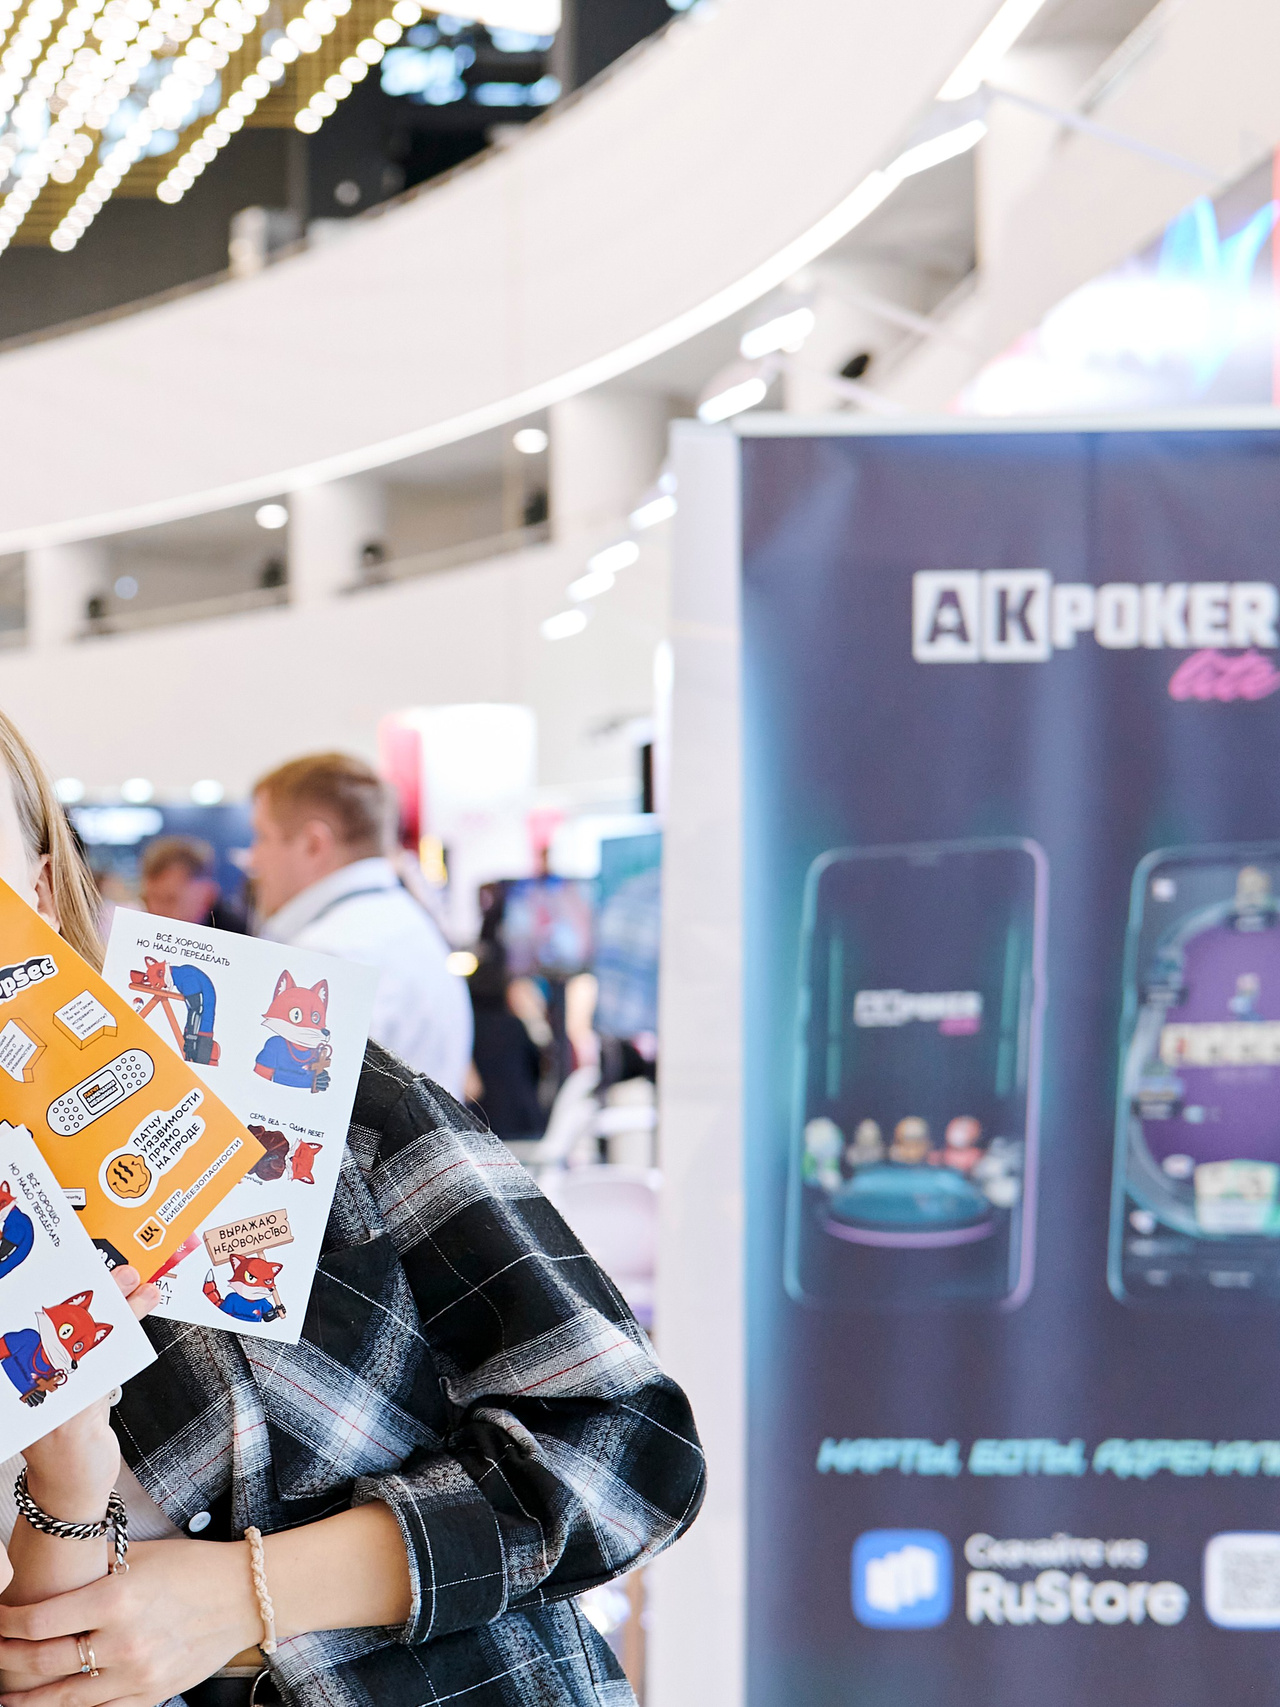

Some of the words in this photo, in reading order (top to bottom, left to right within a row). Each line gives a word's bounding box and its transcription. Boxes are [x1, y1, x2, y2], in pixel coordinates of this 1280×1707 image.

[136, 938, 150, 948] НО
[153, 942, 177, 954] НАДО
[180, 949, 230, 967] ПЕРЕДЕЛАТЬ
[156, 933, 172, 943] ВСЁ
[175, 936, 215, 953] ХОРОШО,
[133, 1115, 162, 1146] ПАТЧУ
[140, 1092, 201, 1154] УЯЗВИМОСТИ
[249, 1112, 267, 1122] СЕМЬ
[268, 1118, 280, 1126] БЕД
[289, 1123, 306, 1134] ОДИН
[308, 1128, 325, 1138] RESET
[148, 1128, 181, 1163] ПРЯМО
[155, 1155, 171, 1170] НА
[169, 1122, 201, 1156] ПРОДЕ
[163, 1139, 242, 1223] КИБЕРБЕЗОПАСНОСТИ
[8, 1162, 20, 1176] НО
[17, 1178, 34, 1201] НАДО
[31, 1201, 61, 1248] ПЕРЕДЕЛАТЬ
[26, 1172, 40, 1187] ВСЁ
[36, 1190, 61, 1227] ХОРОШО,
[158, 1189, 182, 1216] ЦЕНТР
[213, 1224, 288, 1255] НЕДОВОЛЬСТВО
[219, 1214, 277, 1240] ВЫРАЖАЮ
[965, 1570, 1189, 1626] RuStore
